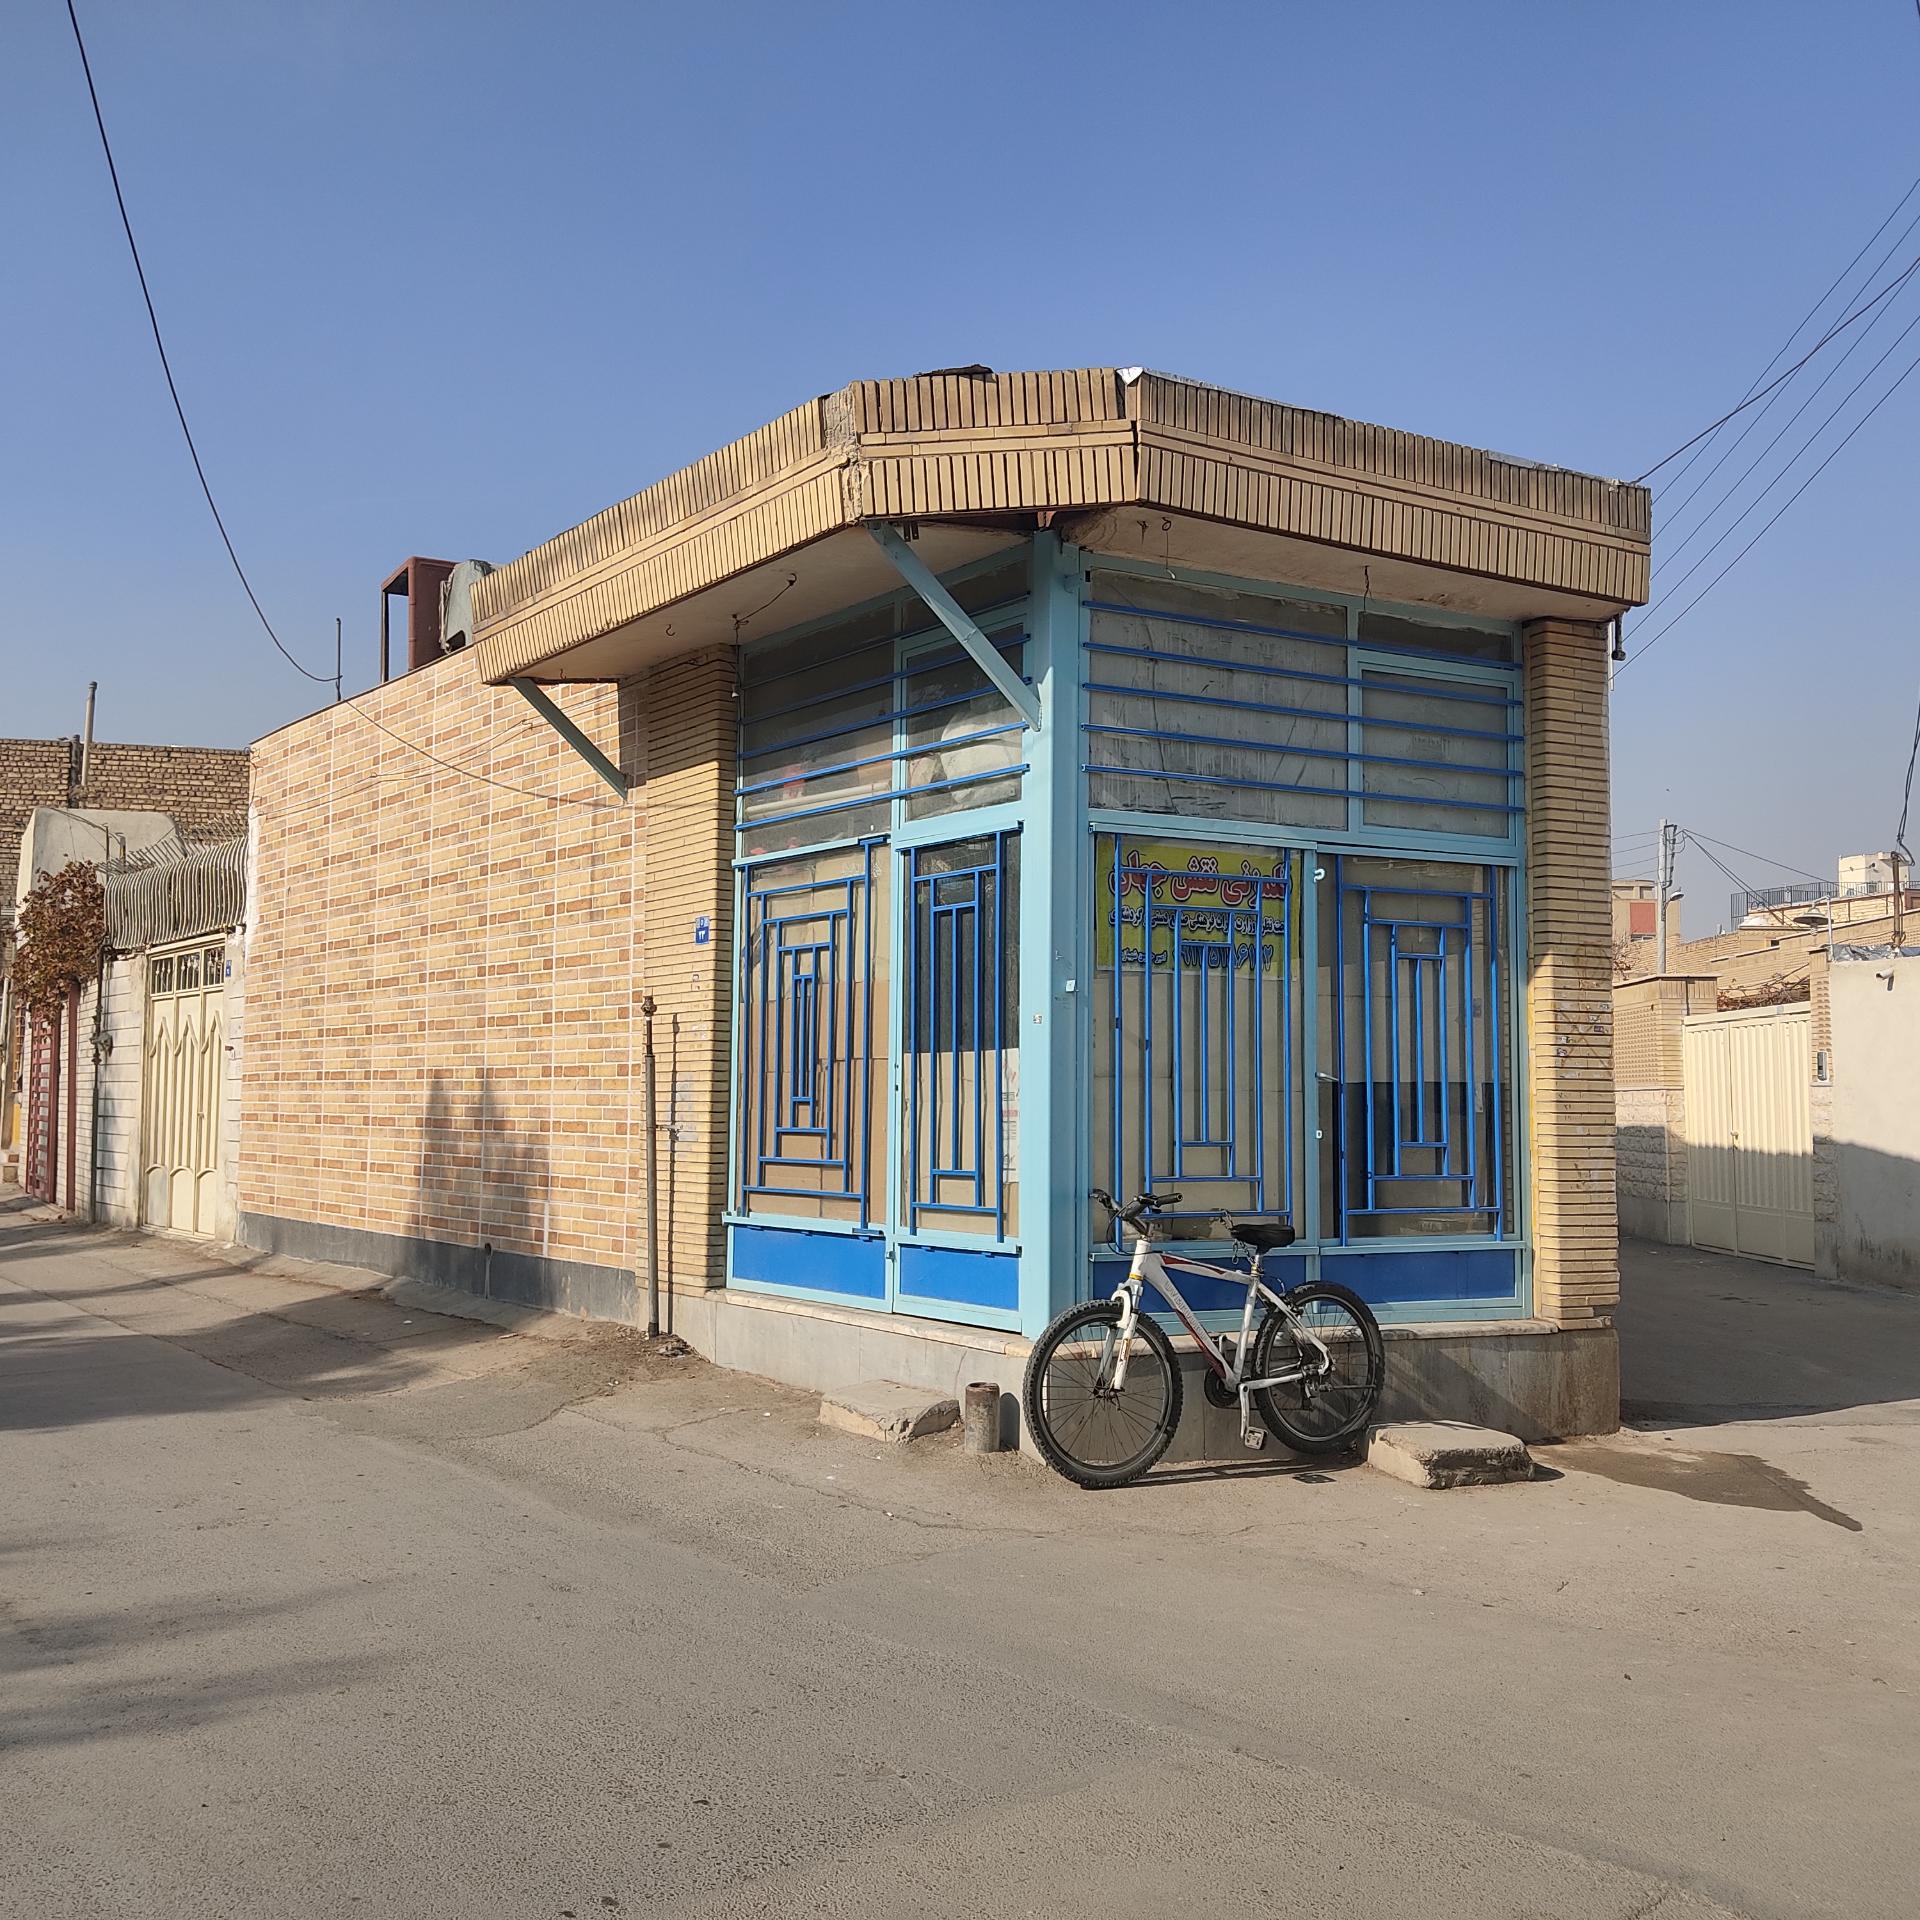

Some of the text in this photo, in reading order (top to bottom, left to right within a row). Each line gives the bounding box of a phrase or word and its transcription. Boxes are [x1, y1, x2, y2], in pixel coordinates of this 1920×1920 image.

[1108, 850, 1292, 908] لمزنی نقش جهان
